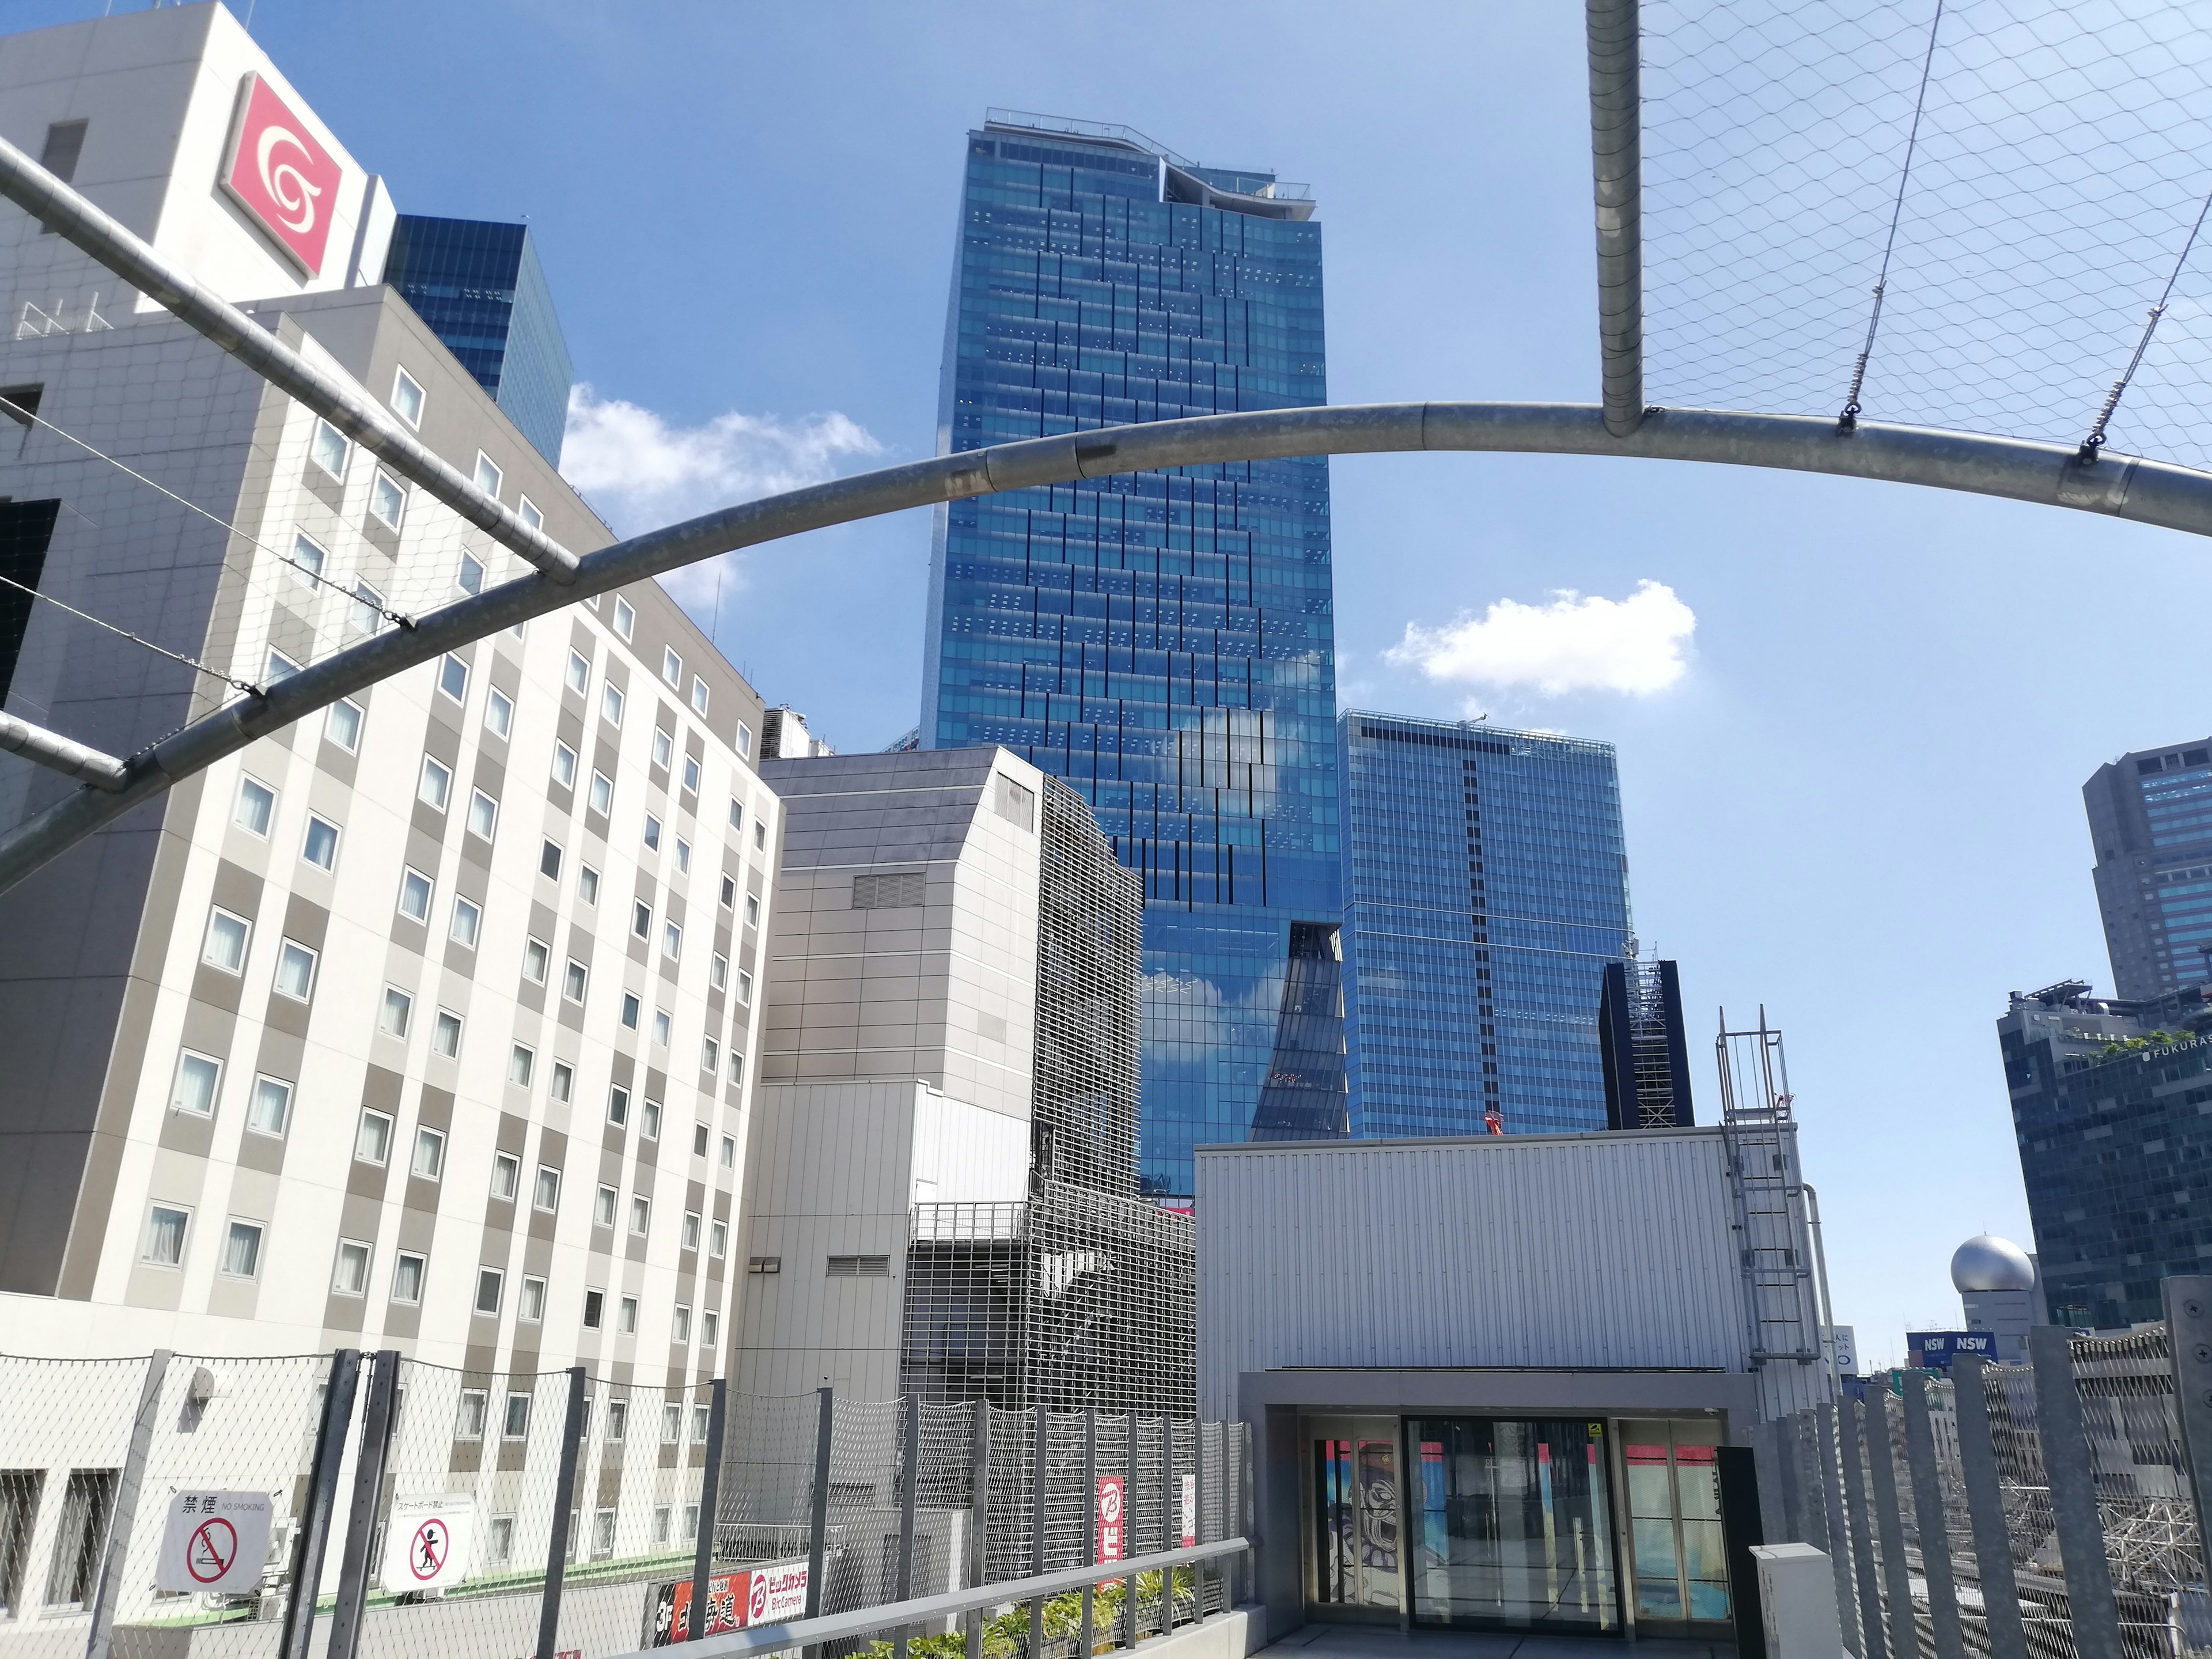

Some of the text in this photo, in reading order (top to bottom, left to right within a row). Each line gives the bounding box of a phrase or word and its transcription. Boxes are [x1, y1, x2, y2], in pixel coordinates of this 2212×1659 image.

[1925, 1338, 1945, 1351] NSW
[1957, 1337, 1987, 1350] NSW
[182, 1495, 217, 1514] 禁煙
[398, 1501, 443, 1510] スケートボード禁止
[769, 1570, 808, 1594] ビックカメラ
[656, 1601, 673, 1632] 3F
